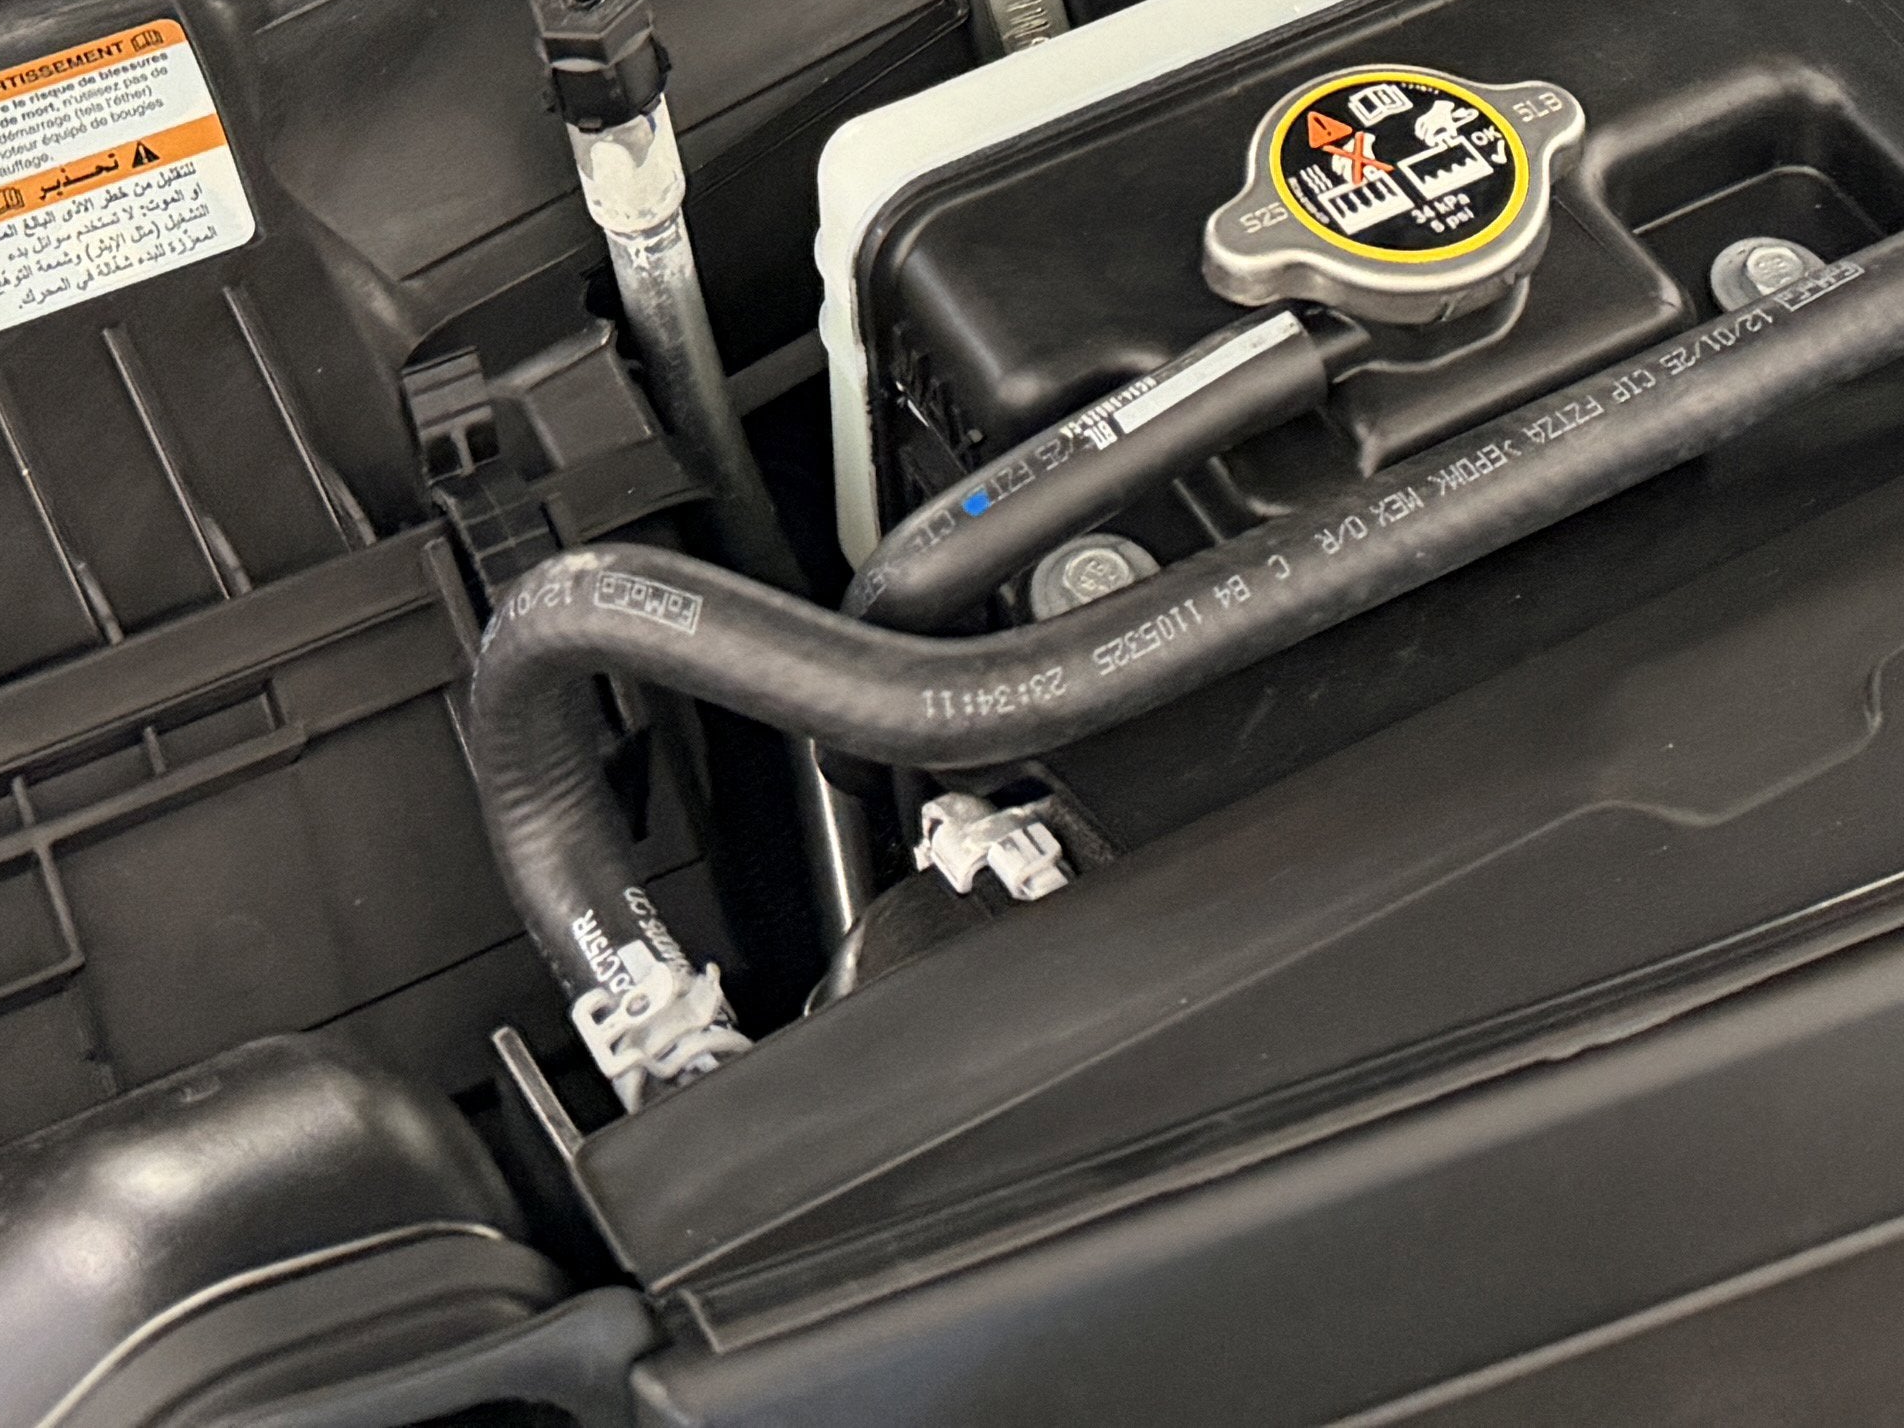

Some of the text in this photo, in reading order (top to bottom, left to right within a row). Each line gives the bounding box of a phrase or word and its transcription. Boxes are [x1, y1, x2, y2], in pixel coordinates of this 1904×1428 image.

[0, 114, 19, 130] de
[122, 71, 150, 93] pas
[151, 65, 169, 80] de
[29, 81, 75, 107] risque
[77, 71, 96, 87] de
[98, 51, 169, 82] blessures
[91, 115, 109, 131] de
[110, 97, 166, 124] bougies
[1470, 125, 1502, 147] OK
[1411, 191, 1471, 225] 34 kPa
[1447, 207, 1474, 232] psi
[1659, 308, 1774, 377] 12/01/25
[1611, 367, 1657, 406] CIP
[1370, 490, 1425, 529] MEX
[1267, 553, 1292, 580] C
[1213, 575, 1251, 611] B4
[921, 666, 1067, 719] 23:34:11
